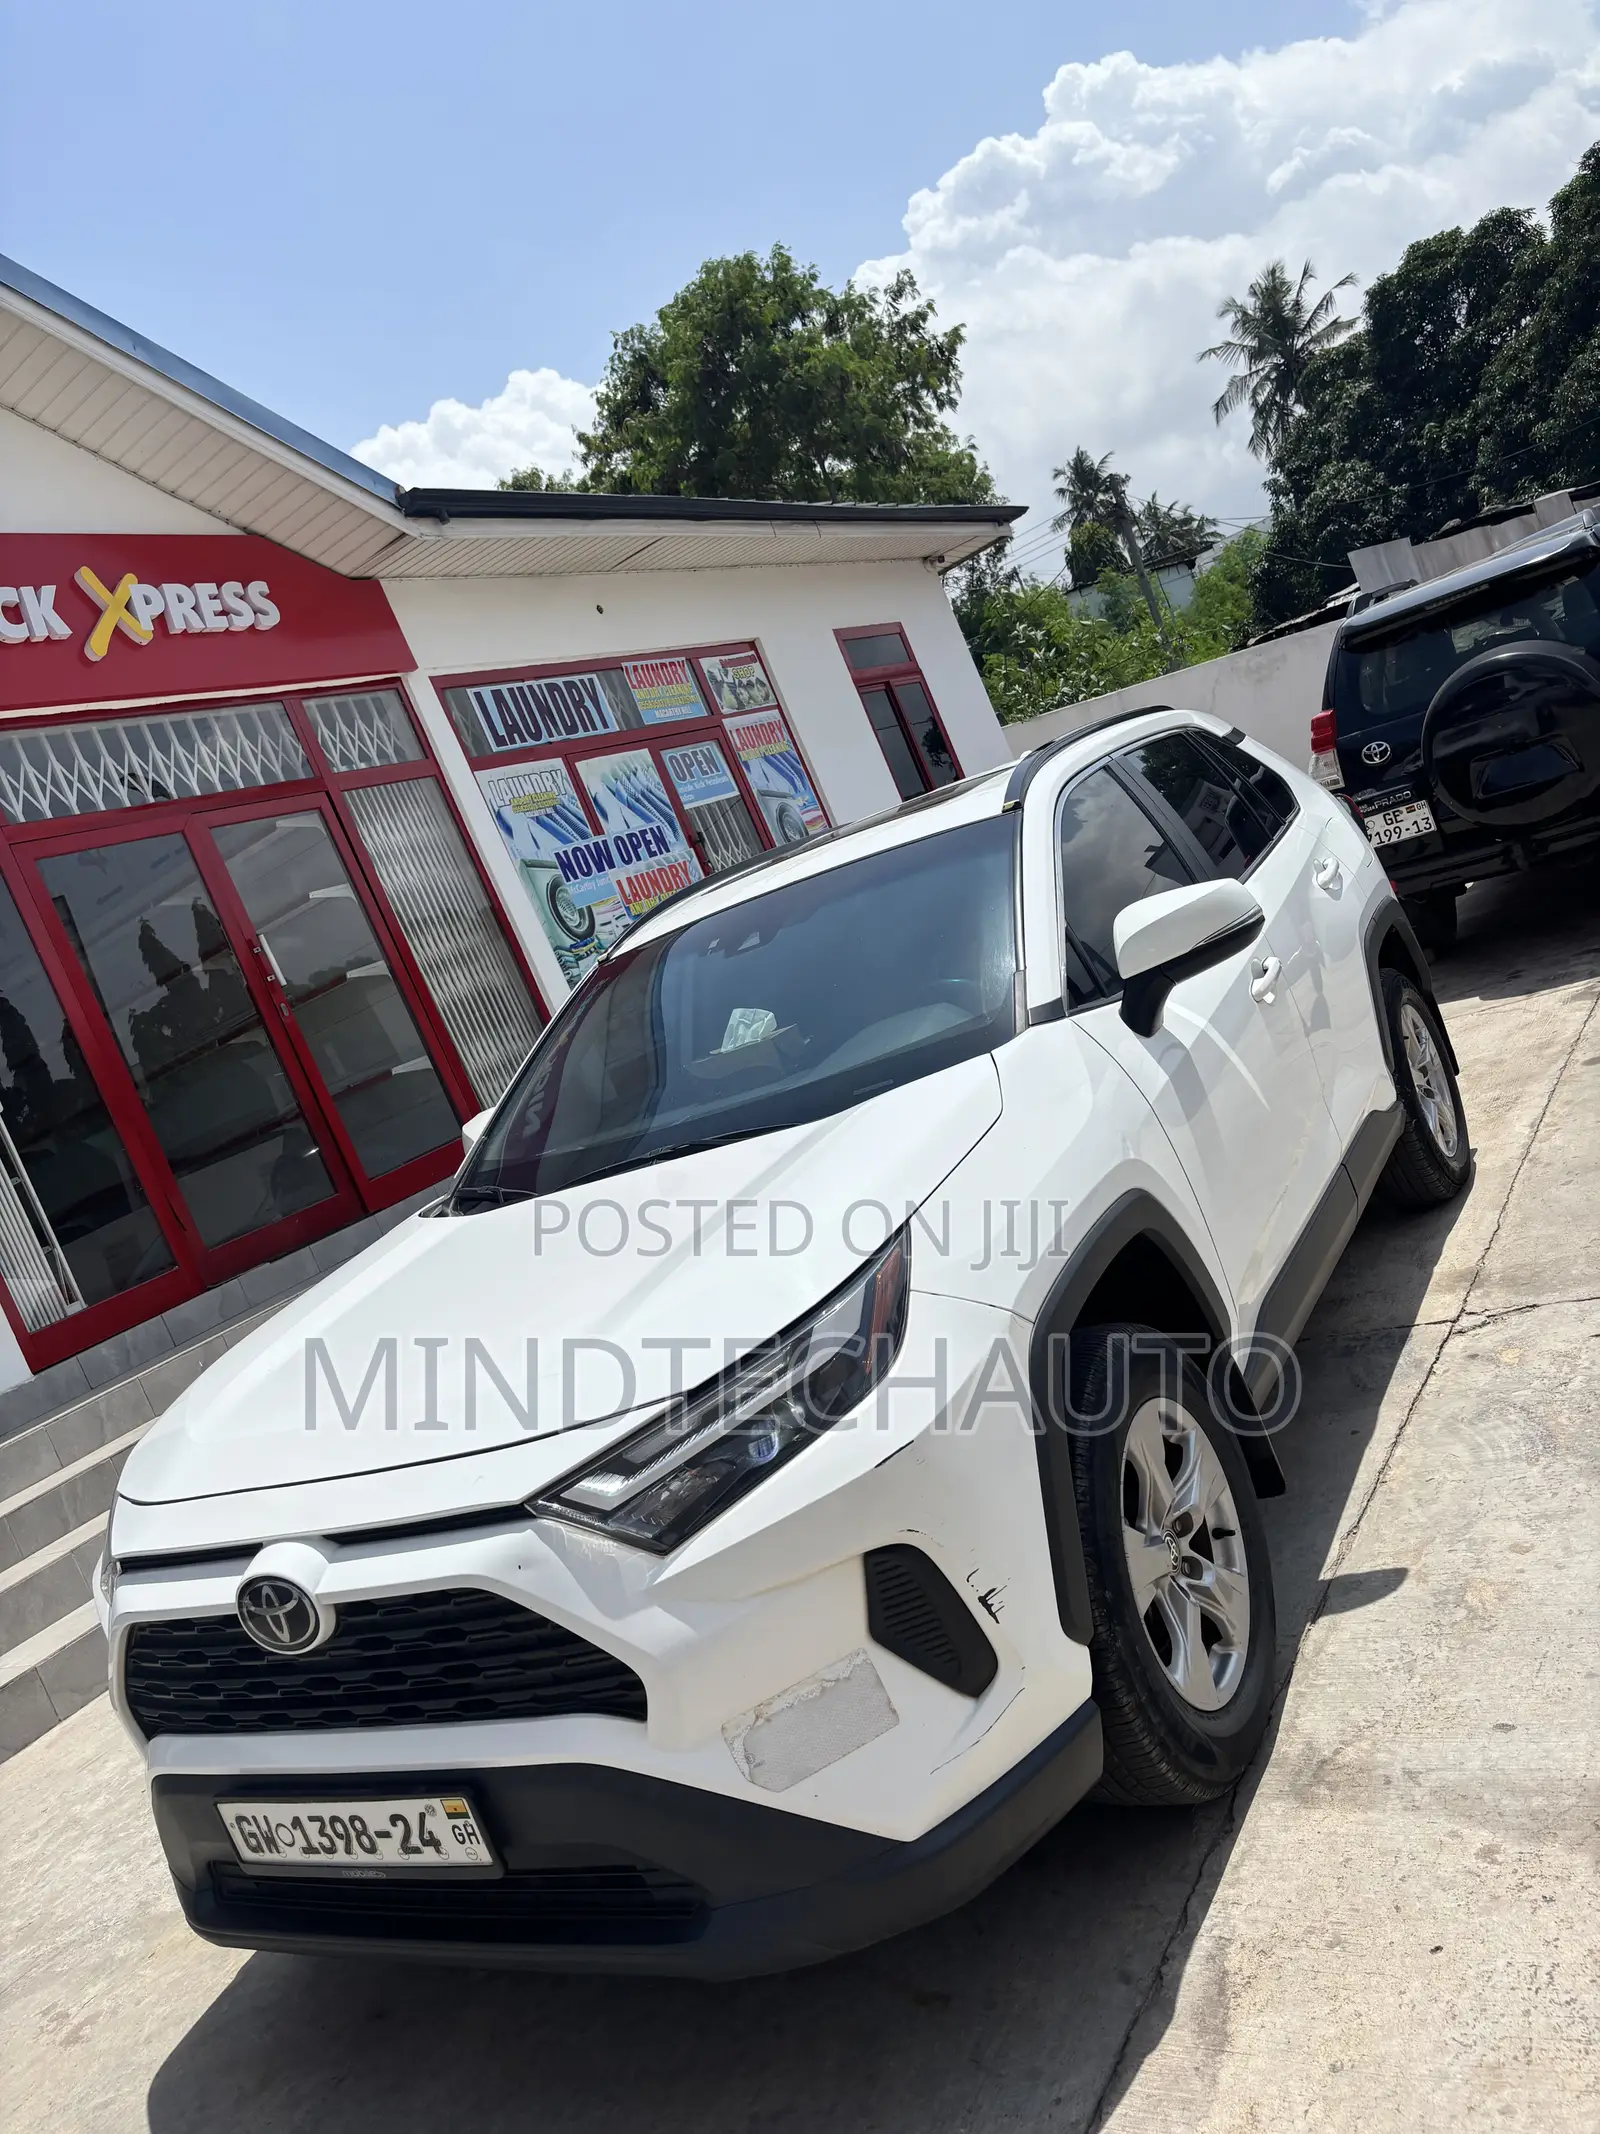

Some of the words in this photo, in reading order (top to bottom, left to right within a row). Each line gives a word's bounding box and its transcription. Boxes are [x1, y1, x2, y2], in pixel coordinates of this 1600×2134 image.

[74, 566, 281, 662] XPRESS
[624, 660, 689, 690] LAUNDRY
[732, 666, 755, 679] SHOP
[473, 678, 610, 748] LAUNDRY
[729, 720, 785, 752] LAUNDRY
[667, 747, 721, 783] OPEN
[488, 768, 567, 808] LAUNDRY
[1374, 790, 1412, 809] PRADO
[1383, 810, 1404, 826] GE
[1416, 801, 1427, 811] GH
[554, 839, 616, 882] NOW
[613, 825, 671, 866] OPEN
[616, 860, 692, 905] LAUNDRY
[234, 1814, 282, 1854] GW
[290, 1811, 442, 1856] 1398-24
[451, 1822, 481, 1846] GH
